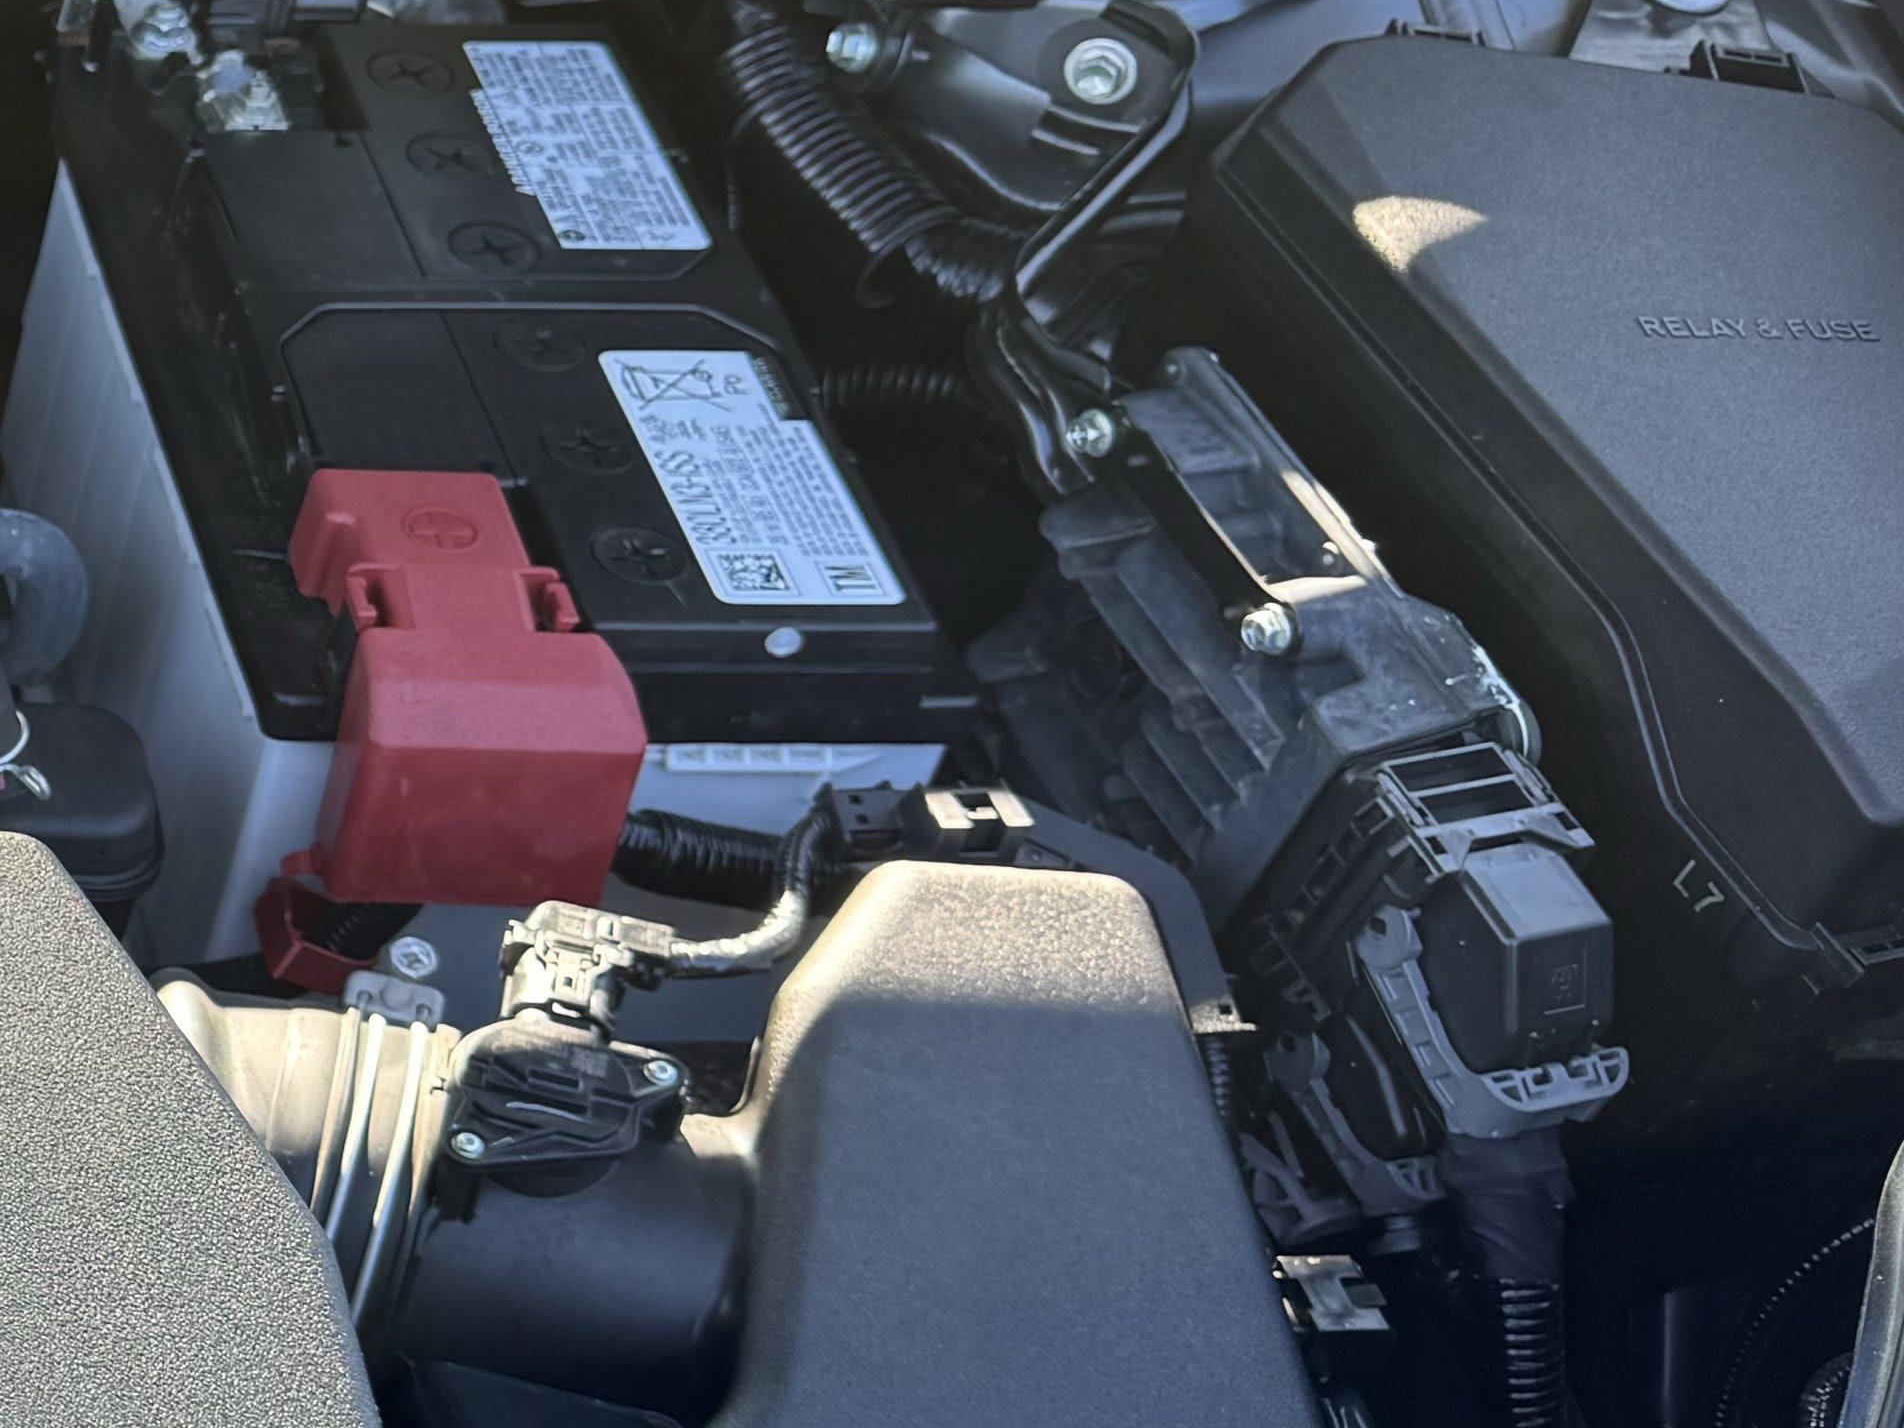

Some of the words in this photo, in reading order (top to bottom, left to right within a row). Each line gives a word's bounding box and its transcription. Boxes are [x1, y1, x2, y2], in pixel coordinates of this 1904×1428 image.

[1636, 315, 1746, 339] RELAY
[1756, 318, 1781, 340] &
[1785, 318, 1881, 342] FUSE
